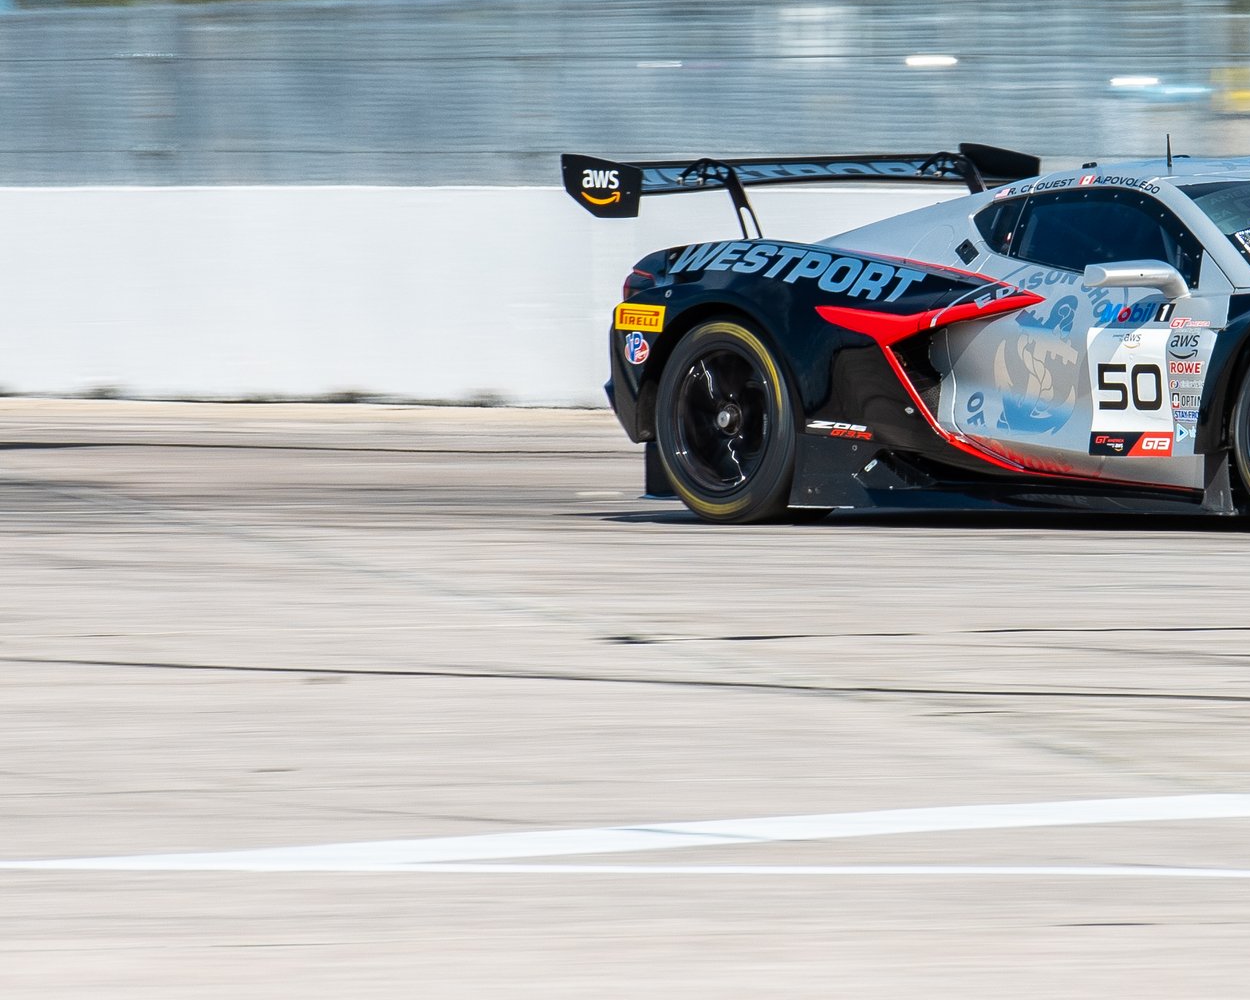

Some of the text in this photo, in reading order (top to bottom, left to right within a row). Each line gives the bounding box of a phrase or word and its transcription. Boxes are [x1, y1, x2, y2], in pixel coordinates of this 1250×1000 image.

[582, 169, 620, 190] aws
[1020, 178, 1075, 193] CHOUEST
[669, 242, 925, 302] WESTPORT
[974, 271, 1078, 309] EDISON
[619, 308, 660, 327] PIRELLI
[1099, 303, 1156, 322] Mobil
[1170, 318, 1191, 328] GT
[1124, 333, 1142, 342] aws
[1170, 335, 1200, 348] aws
[1170, 362, 1201, 374] ROWE
[1098, 364, 1162, 410] 50
[1142, 437, 1171, 450] GT3
